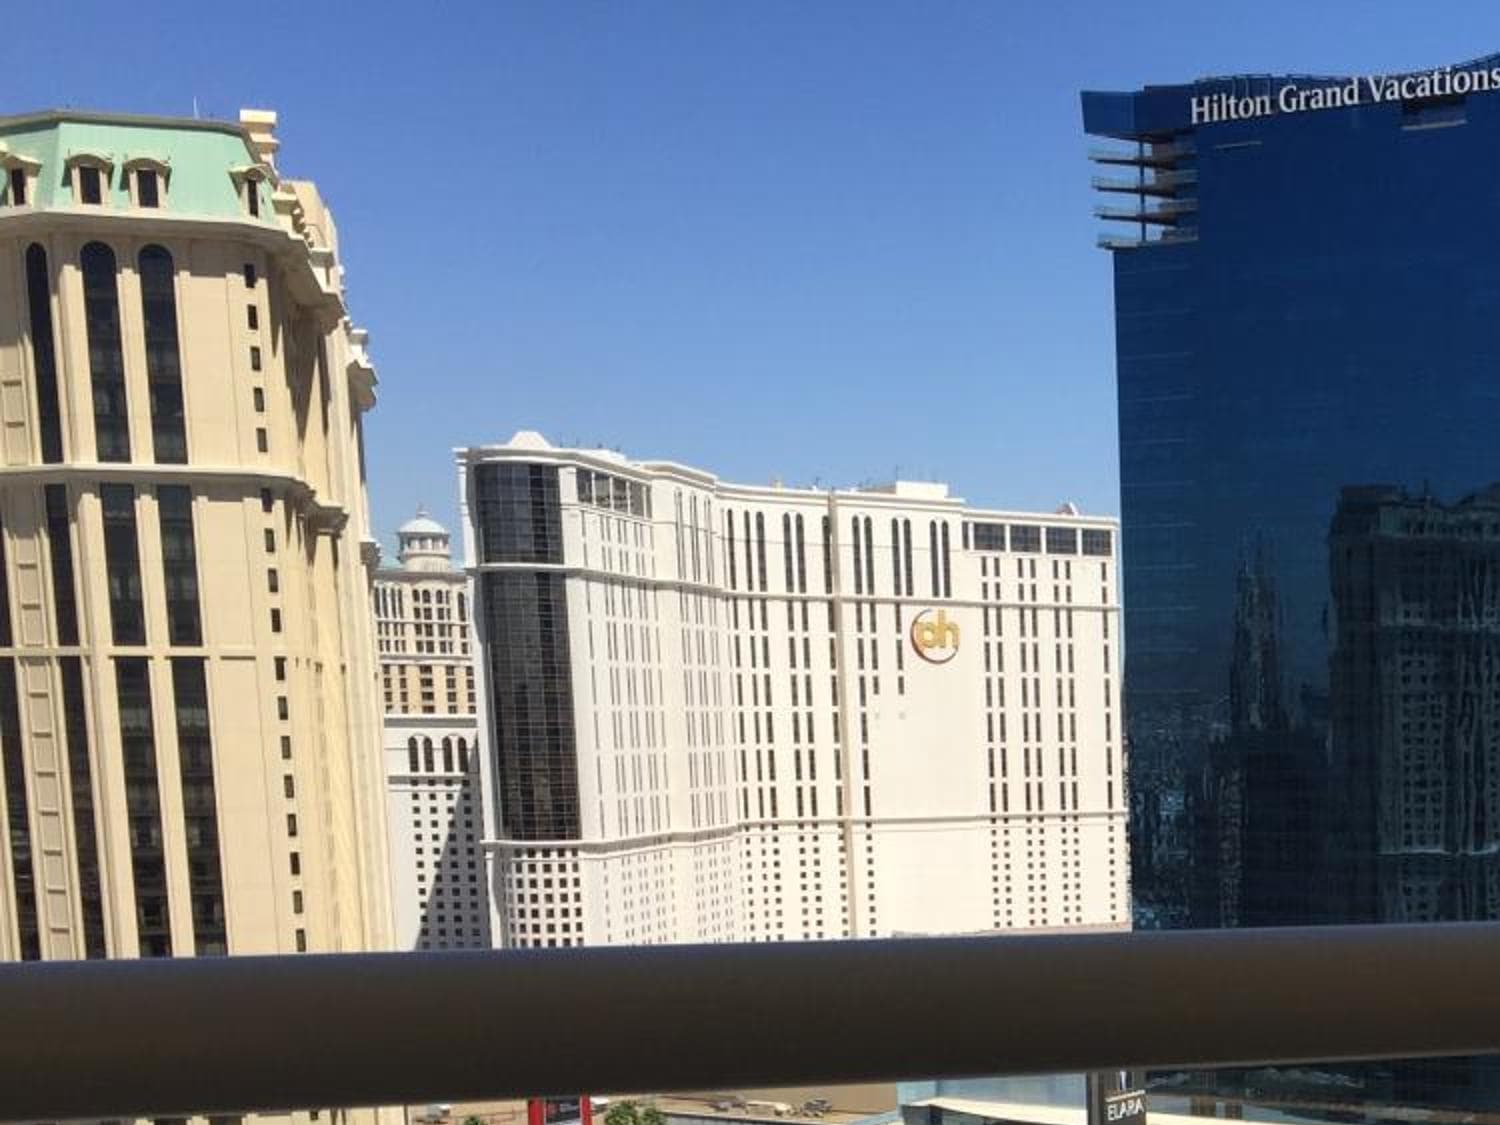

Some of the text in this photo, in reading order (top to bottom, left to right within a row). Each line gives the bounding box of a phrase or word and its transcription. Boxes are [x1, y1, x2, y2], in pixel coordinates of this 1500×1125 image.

[1190, 94, 1272, 125] Hilton
[1278, 76, 1359, 113] Grand
[1107, 1097, 1145, 1121] ELARA
